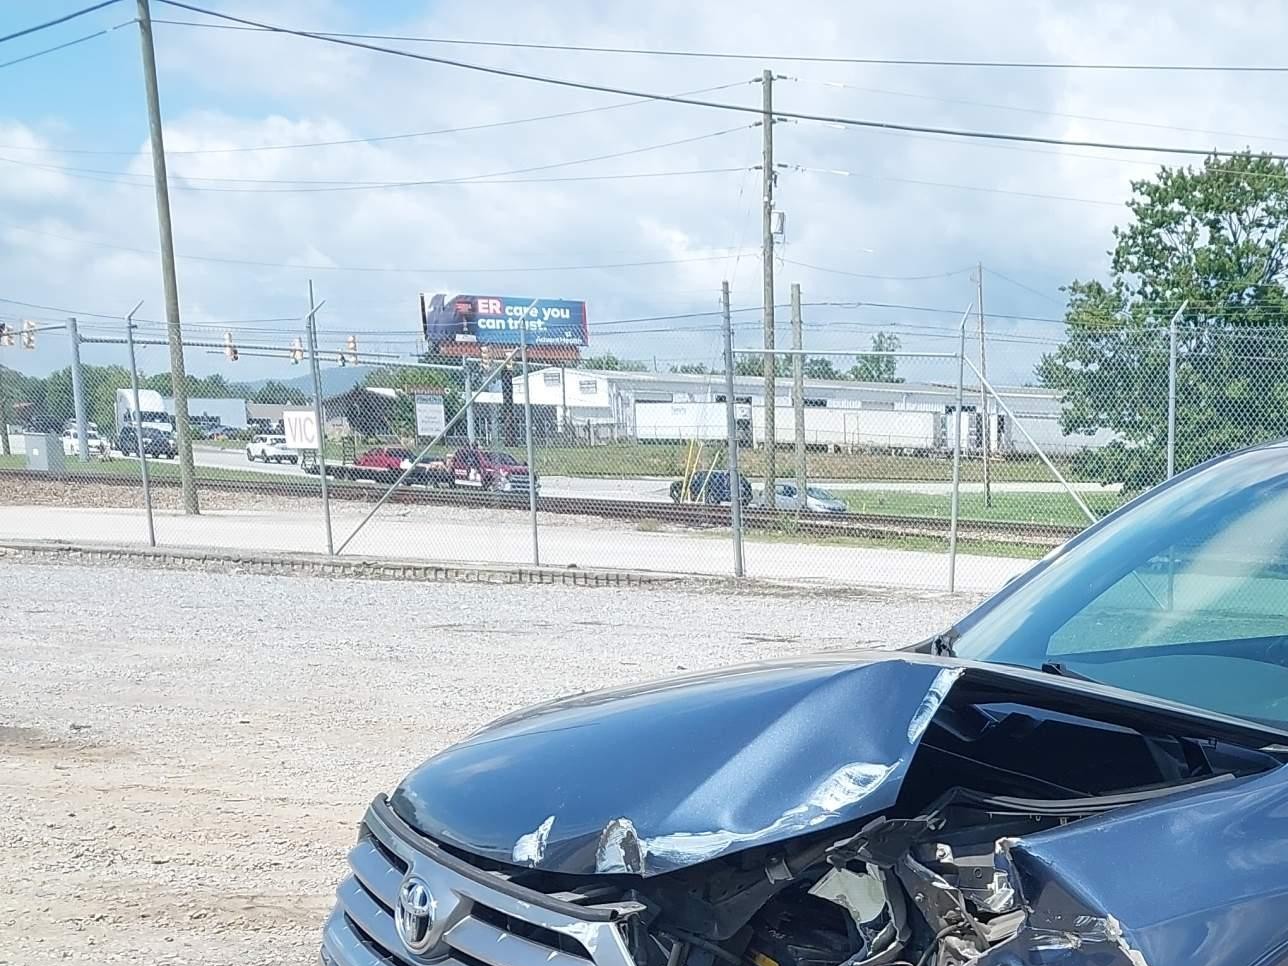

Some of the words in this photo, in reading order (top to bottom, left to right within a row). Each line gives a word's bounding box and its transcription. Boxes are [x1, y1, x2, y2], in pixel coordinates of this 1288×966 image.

[477, 298, 502, 314] ER
[505, 305, 539, 317] care
[541, 307, 570, 321] you
[477, 319, 506, 330] can
[288, 416, 315, 444] VIC
